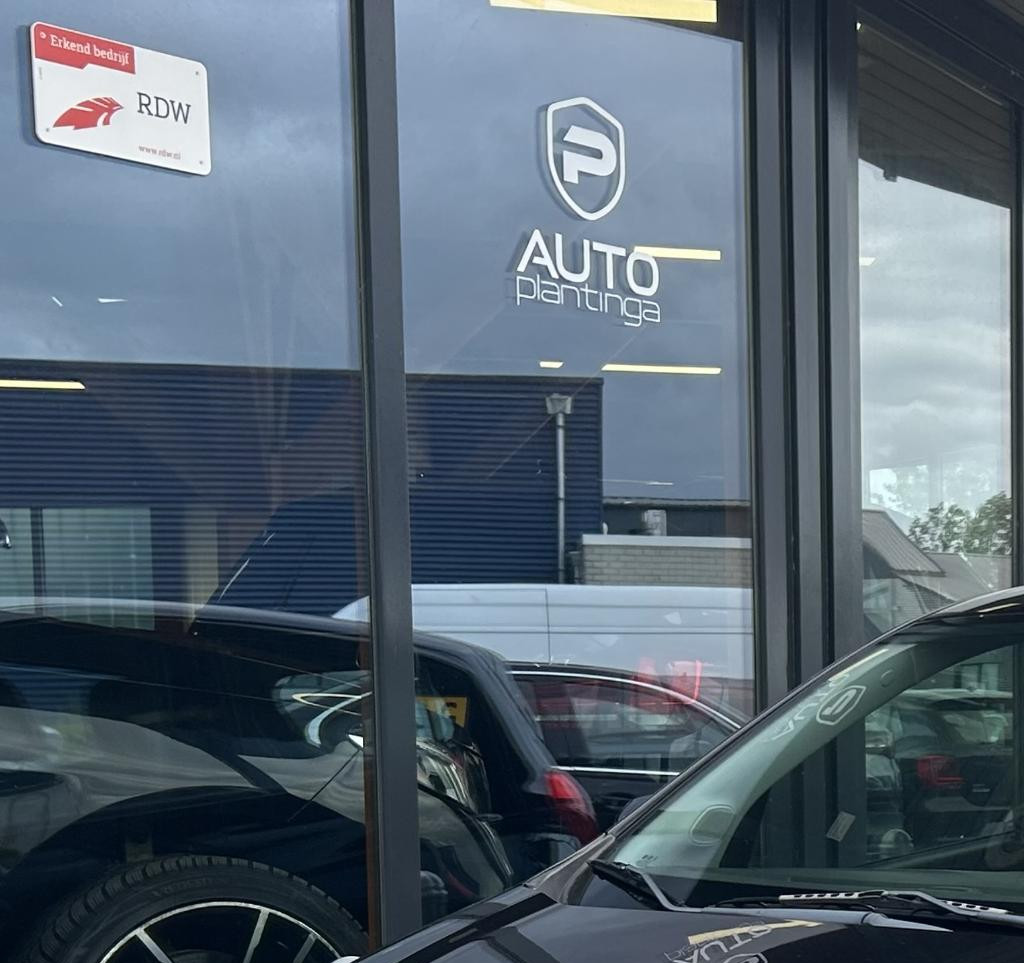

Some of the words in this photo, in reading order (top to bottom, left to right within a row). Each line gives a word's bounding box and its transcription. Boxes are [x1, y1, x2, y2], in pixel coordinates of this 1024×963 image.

[49, 34, 91, 55] Erkend
[93, 43, 129, 66] bedrijf
[136, 91, 192, 125] RDW
[516, 228, 660, 297] AUTO
[516, 273, 661, 327] plantinga
